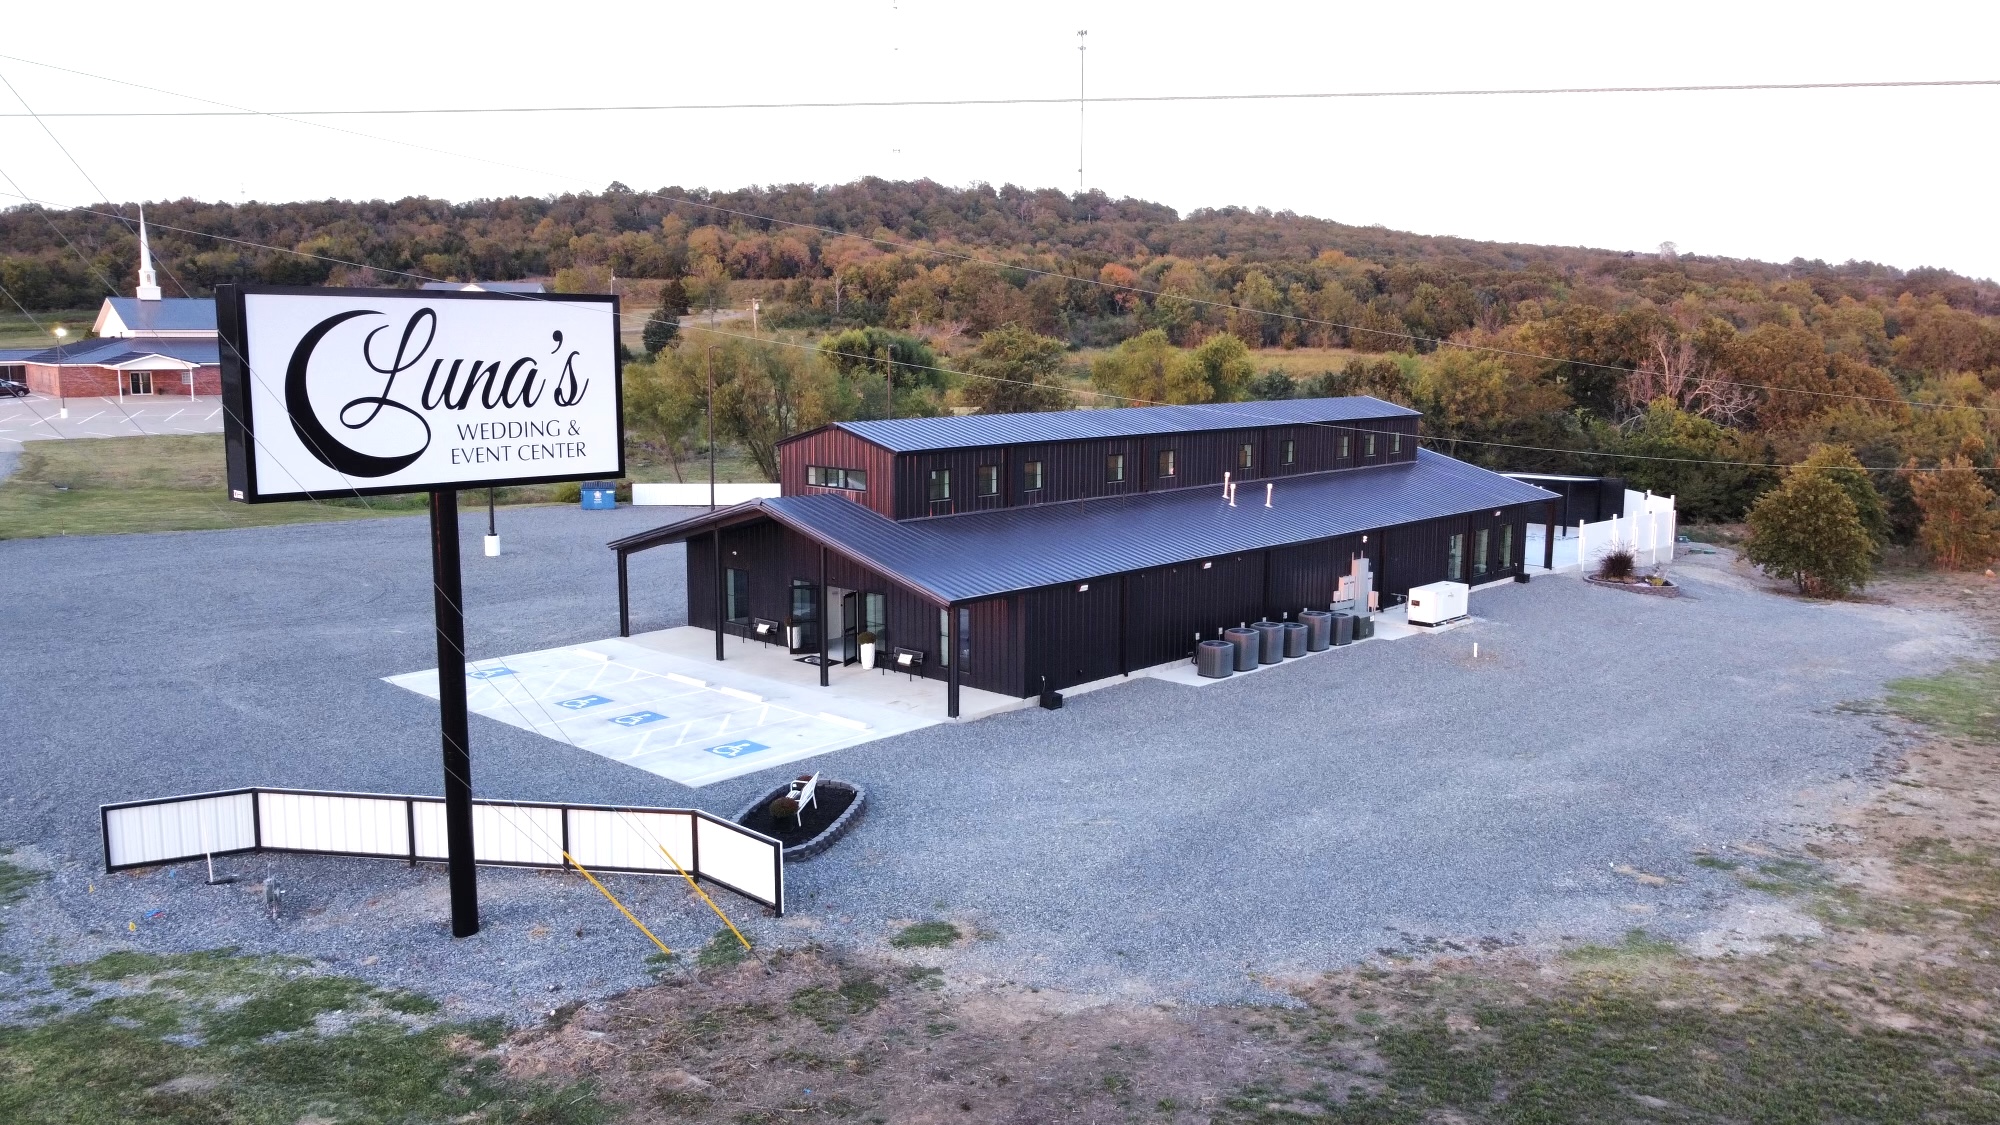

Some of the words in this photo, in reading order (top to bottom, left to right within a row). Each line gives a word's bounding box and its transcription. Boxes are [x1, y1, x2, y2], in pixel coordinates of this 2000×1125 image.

[340, 307, 590, 446] Luna's
[456, 419, 561, 441] WEDDING
[567, 420, 581, 437] &
[451, 445, 512, 465] EVENT
[517, 441, 587, 462] CENTER
